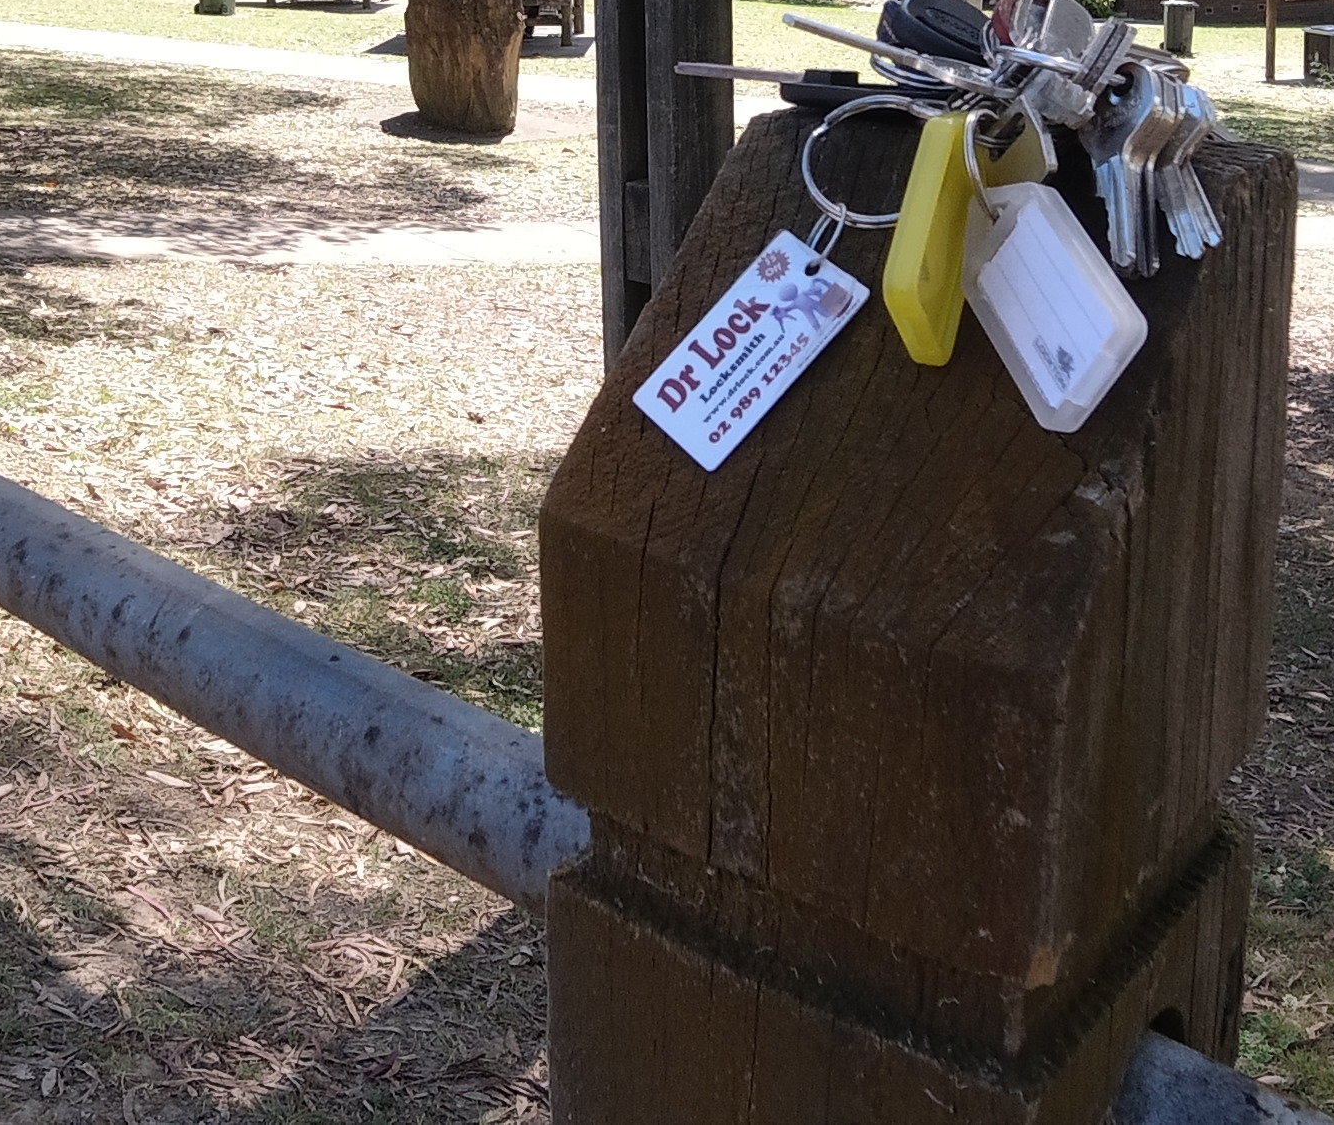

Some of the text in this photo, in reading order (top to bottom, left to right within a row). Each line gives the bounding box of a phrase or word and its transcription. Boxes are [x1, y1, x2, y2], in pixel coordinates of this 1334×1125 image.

[656, 296, 771, 414] Dr Lock
[699, 332, 767, 405] Locksmith
[702, 333, 786, 424] www.drlock.com.au
[708, 332, 810, 445] 02 989 12345
